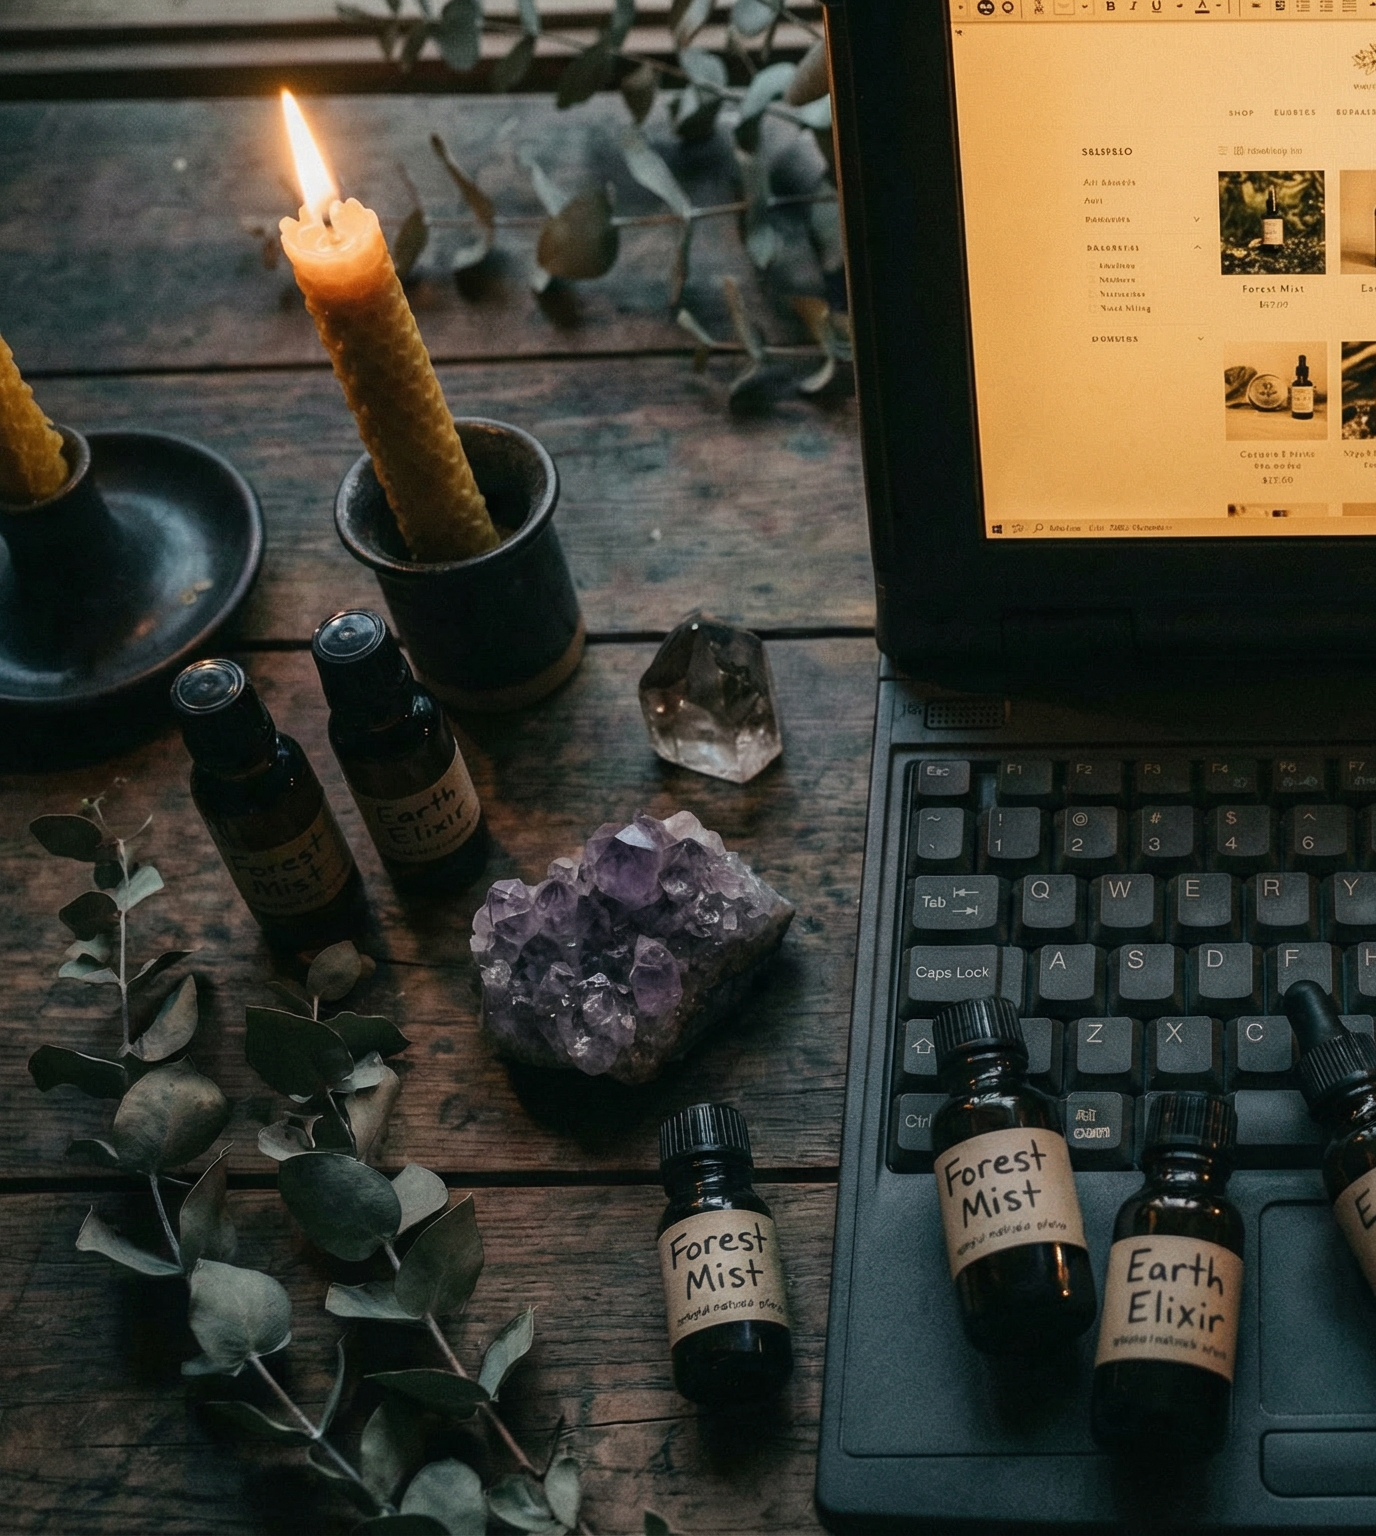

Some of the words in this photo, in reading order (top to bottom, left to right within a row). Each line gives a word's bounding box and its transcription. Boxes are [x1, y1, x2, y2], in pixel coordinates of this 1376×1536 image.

[1243, 285, 1275, 293] Forest
[1007, 764, 1021, 774] F1
[1077, 764, 1092, 774] F2
[1145, 764, 1160, 774] F3
[1349, 761, 1364, 771] F7
[376, 786, 456, 825] Earth
[388, 800, 467, 845] Elixir
[1073, 813, 1088, 826] @
[1150, 813, 1161, 823] #
[1226, 811, 1236, 824] $
[996, 840, 1001, 851] 1
[1072, 838, 1082, 851] 2
[1149, 838, 1160, 850] 3
[1226, 837, 1237, 849] 4
[1303, 836, 1314, 849] 6
[230, 832, 324, 879] Forest
[252, 864, 325, 897] Mist
[1186, 880, 1199, 896] E
[1265, 880, 1279, 896] R
[1344, 879, 1358, 895] Y
[1032, 881, 1049, 898] Q
[1109, 881, 1131, 897] W
[922, 896, 946, 907] Tab
[1049, 952, 1066, 969] A
[1128, 950, 1143, 968] S
[1207, 950, 1223, 967] D
[1286, 950, 1299, 967] F
[916, 967, 951, 981] Caps
[957, 967, 988, 978] Lock
[1087, 1024, 1102, 1042] Z
[1166, 1023, 1182, 1043] X
[1247, 1024, 1263, 1041] C
[944, 1138, 1046, 1198] Forest
[961, 1179, 1041, 1229] Mist
[669, 1221, 767, 1271] Forest
[687, 1258, 764, 1301] Mist
[1127, 1247, 1224, 1296] Earth
[1128, 1289, 1225, 1333] Elixir
